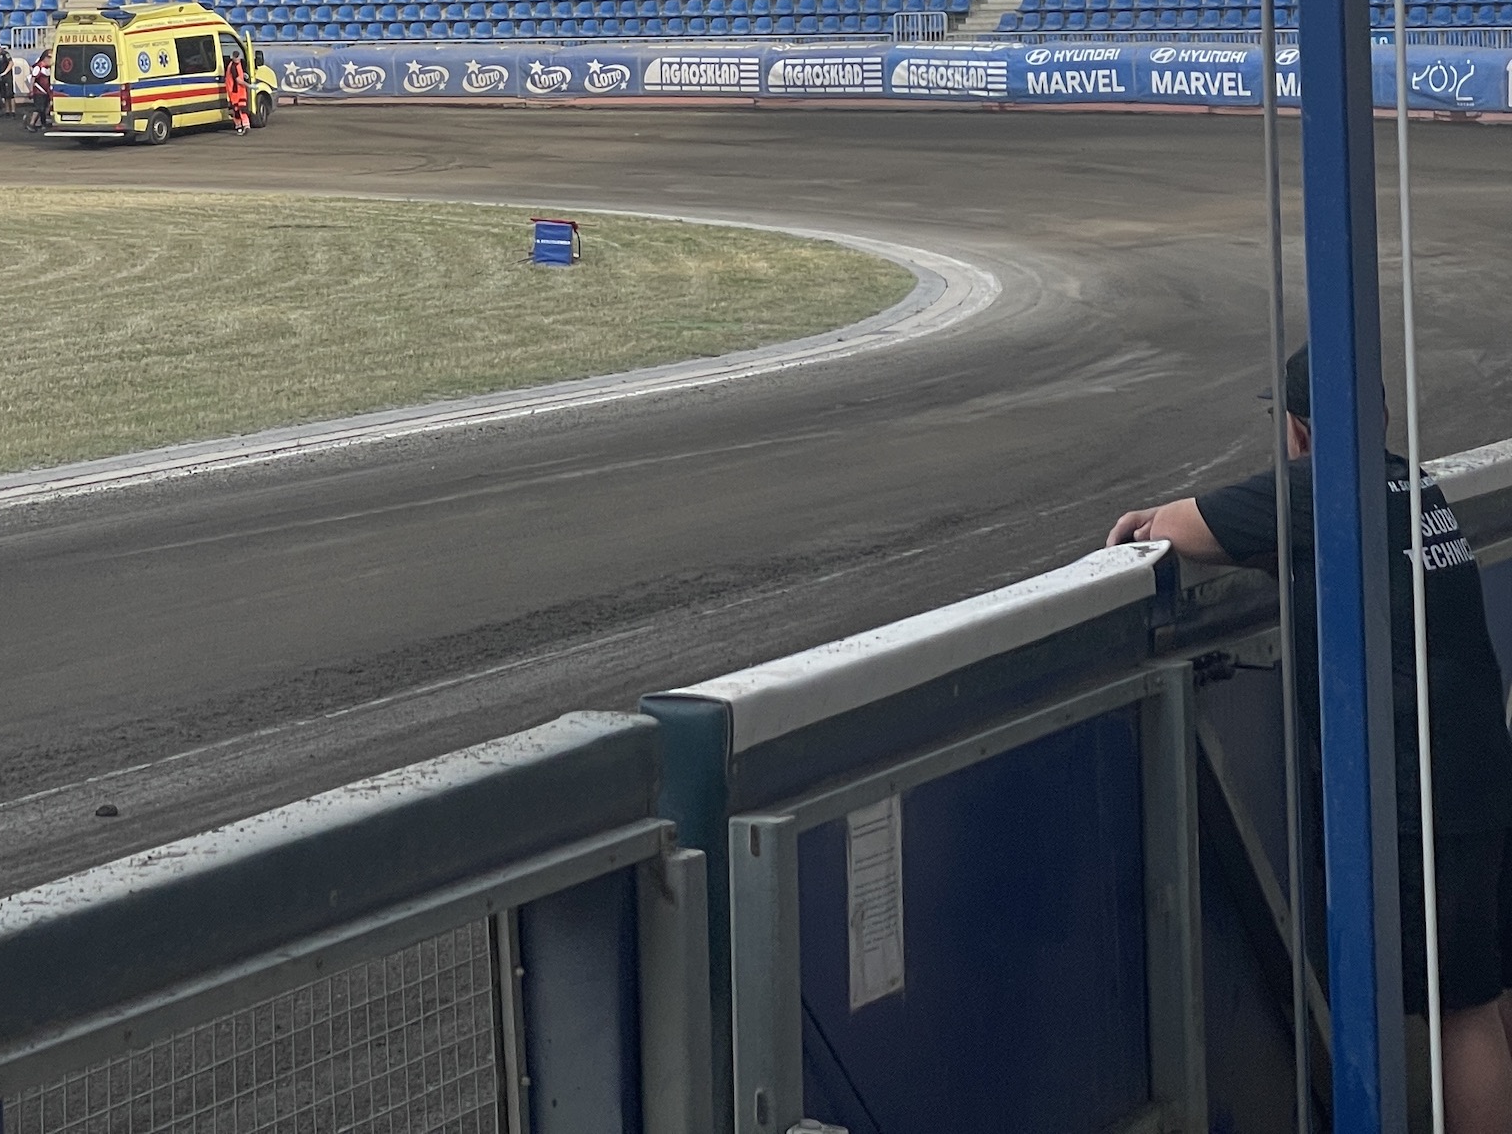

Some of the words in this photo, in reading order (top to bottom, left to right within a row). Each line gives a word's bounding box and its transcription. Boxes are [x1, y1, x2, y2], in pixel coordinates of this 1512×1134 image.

[59, 34, 113, 44] AMBULANS
[1054, 48, 1122, 63] HYUNDAI
[1178, 49, 1248, 64] HYUNDAI
[289, 72, 317, 88] LOTTO
[348, 71, 377, 88] LOTTO
[412, 71, 440, 87] LOTTO
[471, 71, 500, 87] LOTTO
[535, 71, 563, 88] LOTTO
[593, 70, 622, 87] LOTTO
[1027, 69, 1125, 95] MARVEL
[1151, 71, 1252, 97] MARVEL
